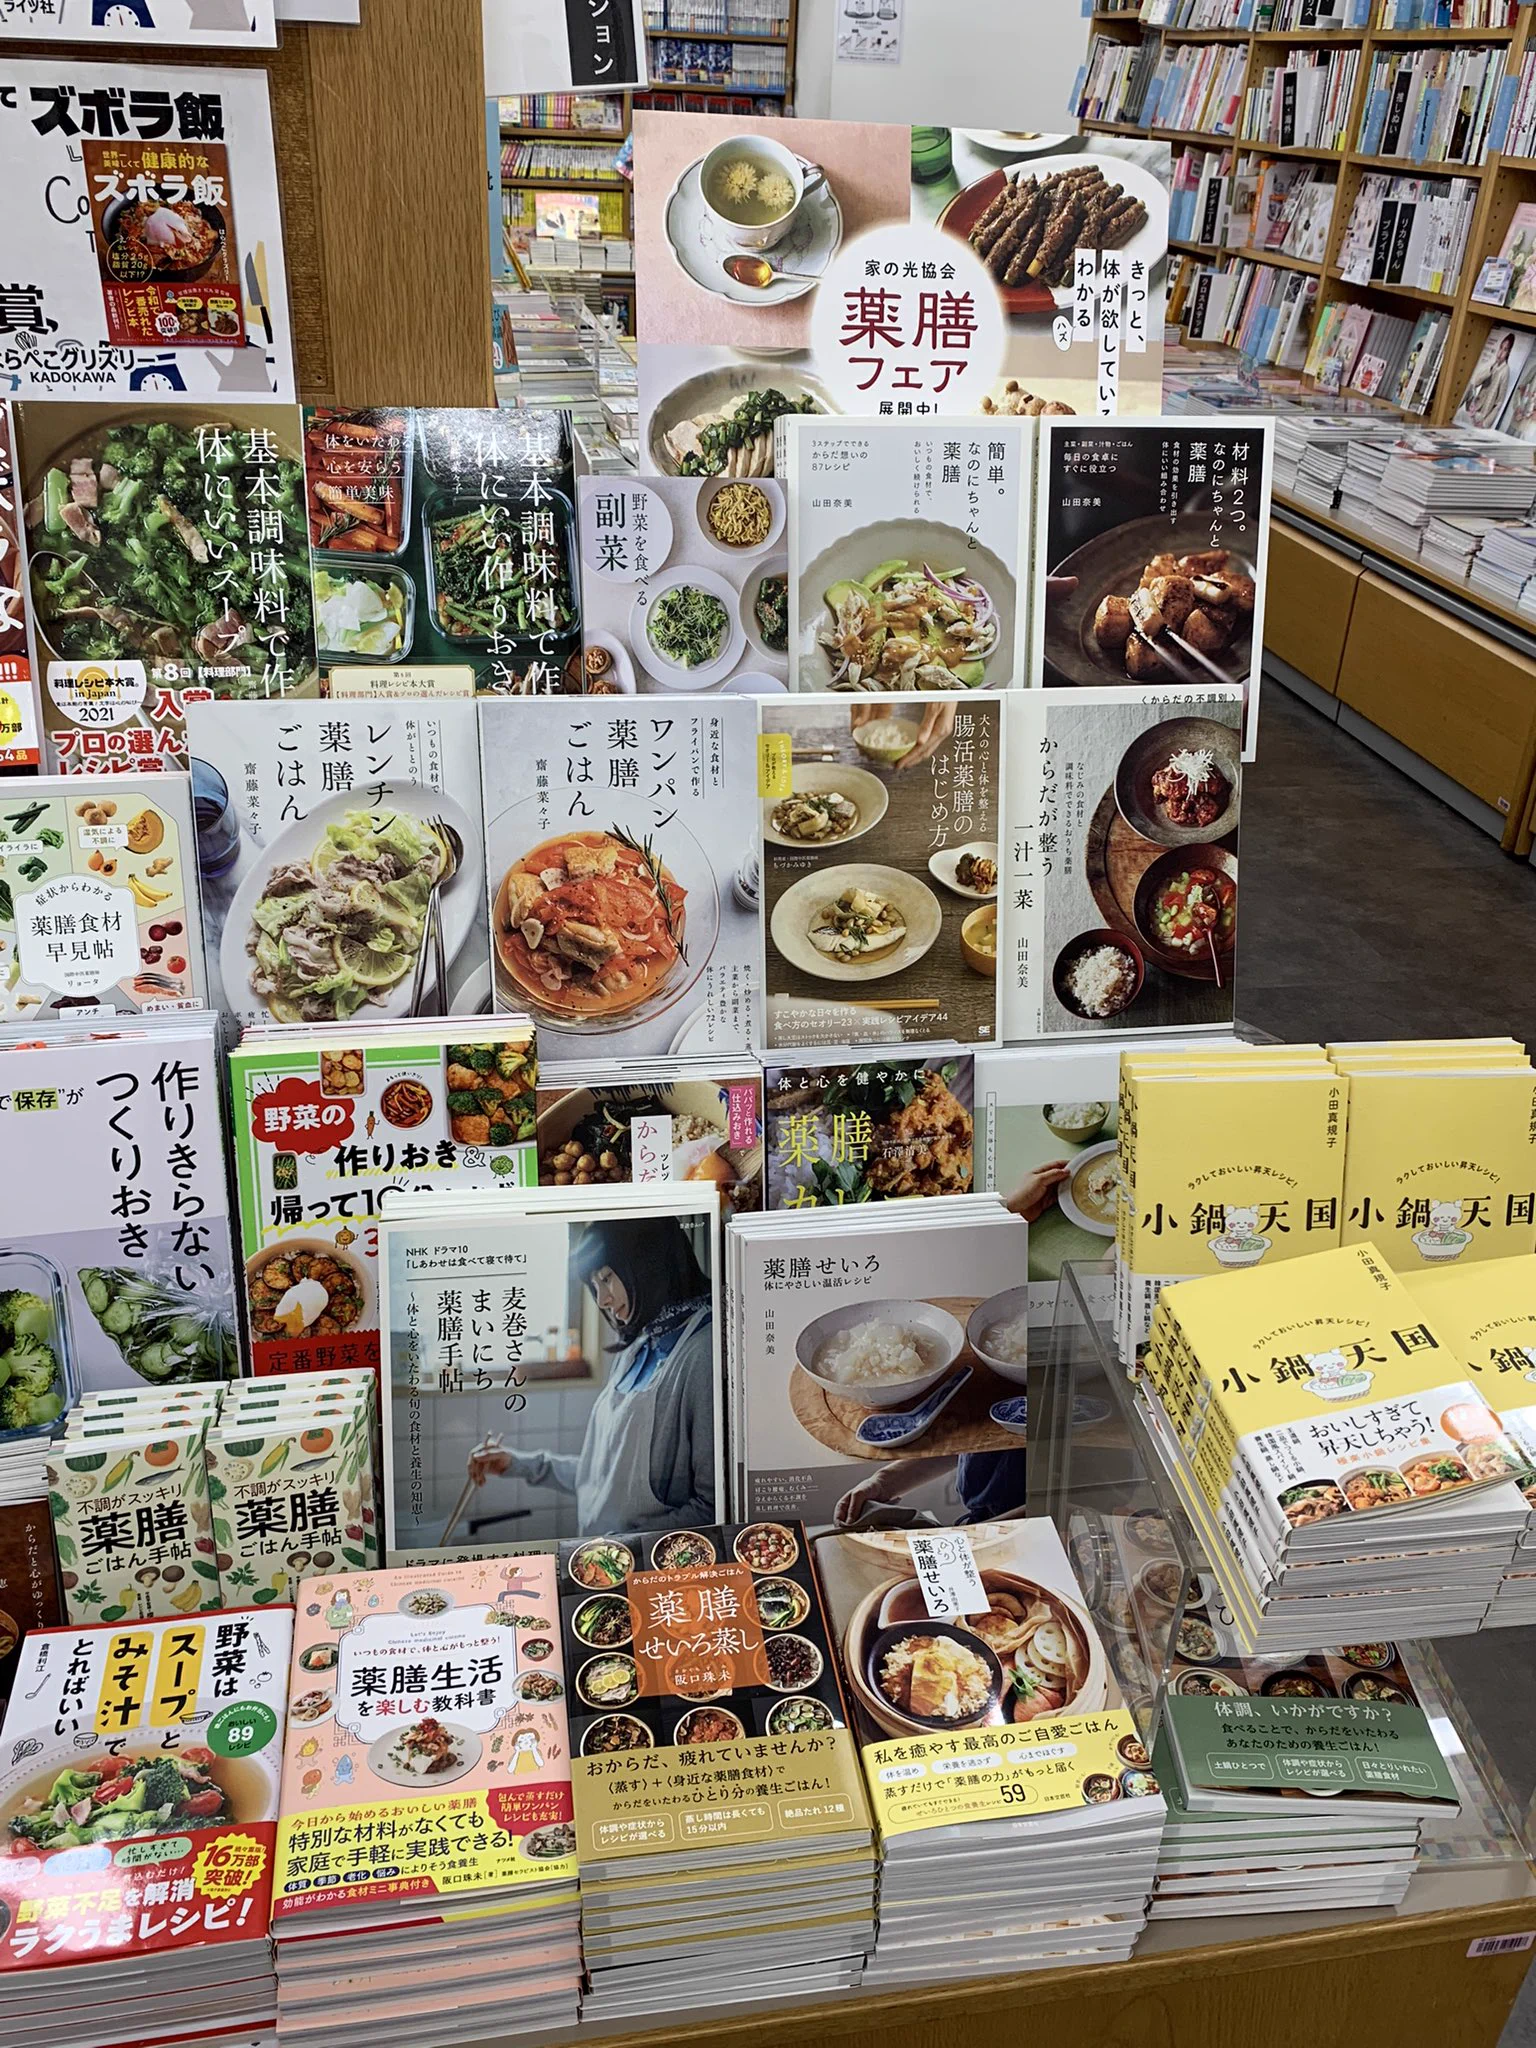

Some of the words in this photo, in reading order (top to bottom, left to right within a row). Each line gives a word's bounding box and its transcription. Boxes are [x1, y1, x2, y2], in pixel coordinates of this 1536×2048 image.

[29, 85, 225, 140] ズボラ飯
[141, 151, 209, 170] 健康的な
[93, 169, 228, 207] ズボラ飯
[1391, 217, 1409, 270] リカちゃん
[865, 260, 956, 280] 家の光協会
[122, 287, 139, 328] レシピ本
[1077, 260, 1095, 327] わかる
[1130, 260, 1146, 343] きっと、
[839, 286, 978, 350] 薬膳
[1056, 321, 1068, 343] ハズ
[30, 372, 116, 383] KADOKAWA
[848, 357, 968, 393] フェア
[811, 439, 870, 448] 3ステップでできる
[812, 450, 869, 460] からだ想いの
[1063, 452, 1119, 462] 毎日の食卓に
[811, 462, 851, 472] 87レシピ
[913, 440, 922, 514] おいしく続けられる
[941, 441, 962, 484] 薬膳
[986, 441, 1007, 496] 簡単。
[1062, 463, 1118, 474] すぐに役立つ
[1159, 441, 1170, 513] 体にいい組み合わせ
[1187, 442, 1208, 484] 薬膳
[328, 484, 395, 501] 簡単美味
[965, 442, 981, 550] なのにちゃんと
[1170, 441, 1181, 525] 食材の効果を引き出す
[1209, 442, 1227, 548] なのにちゃんと
[812, 498, 853, 508] 山田奈美
[1062, 497, 1102, 507] 山田奈美
[195, 428, 249, 656] 体にいいスープ
[595, 492, 629, 572] 副菜
[474, 432, 518, 692] 体にいい作りおき
[632, 492, 650, 607] 野菜を食べる
[151, 663, 191, 681] 第8回
[370, 679, 435, 688] 料理レシピ本大賞
[74, 689, 86, 698] in
[87, 689, 117, 702] Japan
[78, 707, 115, 722] 2021
[319, 722, 356, 792] 薬膳
[405, 720, 418, 787] 体がととのう
[426, 720, 440, 794] いつもの食材で
[607, 719, 641, 789] 薬膳
[690, 718, 701, 798] フライパンで作る
[709, 717, 721, 787] 身近な食材と
[277, 723, 308, 822] ごはん
[366, 723, 398, 835] レンチン
[567, 721, 595, 818] ごはん
[648, 719, 679, 829] ワンパン
[953, 714, 976, 835] 腸活薬膳の
[978, 714, 991, 832] 大人の心と体を整える
[928, 756, 951, 849] はじめ方
[1038, 736, 1059, 878] からだが整う
[1076, 762, 1086, 828] なじみの食材と
[1064, 762, 1074, 876] 調味料でできるおうち薬膳
[1013, 825, 1035, 911] 一汁一菜
[35, 882, 113, 907] 症状からわかる
[30, 911, 122, 937] 薬膳食材
[45, 939, 115, 963] 早見帖
[1017, 937, 1029, 989] 山田奈美
[146, 1002, 200, 1012] めまい・貧血に
[773, 1007, 857, 1018] すこやかな日々を作る
[777, 1069, 927, 1091] 体と心を健やかに
[264, 1105, 346, 1134] 野菜の
[1327, 1087, 1340, 1149] 小田真規子
[778, 1110, 874, 1168] 薬膳
[96, 1071, 152, 1259] つくりおき
[151, 1060, 215, 1292] 作りきらない
[1188, 1165, 1299, 1190] ラクしておいしい昇天レシピ!
[1396, 1160, 1501, 1185] ラクしておいしい昇天レシピ!
[1141, 1199, 1337, 1236] 小鍋天国
[1349, 1192, 1536, 1231] 小鍋天国
[406, 1248, 428, 1257] NHK
[434, 1245, 469, 1255] ドラマ10
[406, 1254, 528, 1270] 「しあわせは食べて寝て待て」
[763, 1254, 881, 1280] 薬膳せいろ
[764, 1275, 872, 1291] 体にやさしい温活レシピ
[1356, 1249, 1391, 1292] 小田真規子
[437, 1290, 464, 1394] 薬膳手帖
[471, 1289, 495, 1391] まいにち
[765, 1308, 775, 1356] 山田奈美
[1253, 1317, 1371, 1350] ラクしておいしい昇天レシピ!
[268, 1342, 379, 1373] 定番野菜を
[501, 1286, 528, 1414] 麦巻さんの
[1221, 1323, 1440, 1394] 小鍋天国
[1309, 1400, 1423, 1439] おいしすぎて
[1319, 1417, 1433, 1458] 昇天しちゃう!
[77, 1484, 182, 1513] 不調がスッキリ
[234, 1471, 336, 1499] 不調がスッキリ
[78, 1500, 189, 1557] 薬膳
[234, 1488, 340, 1541] 薬膳
[85, 1541, 192, 1575] ごはん手帖
[239, 1528, 343, 1558] ごはん手帖
[632, 1567, 744, 1586] からだのトラブル解決ごはん
[913, 1539, 950, 1615] 薬膳せいろ
[953, 1535, 978, 1588] 心と体が整う
[647, 1583, 742, 1630] 薬膳
[213, 1621, 250, 1698] 野菜は
[353, 1636, 501, 1657] いつもの食材で、体と心がもっと整う!
[639, 1628, 760, 1661] せいろ蒸し
[55, 1638, 94, 1737] とればいい
[350, 1655, 504, 1697] 薬膳生活
[674, 1671, 732, 1688] 阪口珠未
[101, 1637, 149, 1757] みそ汁で
[357, 1688, 497, 1717] を楽しむ教科書
[1213, 1701, 1394, 1722] 体調、いかがですか?
[226, 1727, 255, 1743] 89
[228, 1741, 252, 1752] レシピ
[873, 1718, 1119, 1767] 私を癒やす最高のご自愛ごはん
[1221, 1722, 1400, 1740] 食べることで、からだをいたわる
[1226, 1737, 1381, 1754] あなたのための養生ごはん!
[586, 1735, 838, 1778] おからだ、疲れていませんか?
[942, 1756, 993, 1771] 栄養を逃さず
[1018, 1746, 1066, 1761] 心までほぐす
[1214, 1760, 1266, 1772] 土鍋ひとつで
[1282, 1758, 1344, 1769] 体調や症状から
[1362, 1761, 1428, 1775] 日々とりいれたい
[883, 1760, 1077, 1800] 蒸すだけで「薬膳の力」がもっと届く
[885, 1766, 920, 1779] 体を温め
[1285, 1767, 1347, 1779] レシピが選べる
[1365, 1771, 1401, 1781] 薬膳食材
[498, 1791, 565, 1803] 包んで蒸すだけ
[500, 1801, 560, 1813] 簡単ワンパン
[612, 1777, 833, 1811] からだをいたわるひとり分の養生ごはん!
[1001, 1783, 1027, 1805] 59
[291, 1797, 478, 1831] 今日から始めるおいしい薬膳
[599, 1818, 666, 1835] 体調や症状から
[685, 1807, 766, 1824] 蒸し時間は長くても
[686, 1822, 727, 1834] 15分以内
[127, 1841, 179, 1856] 忙しすぎて
[288, 1812, 485, 1853] 特別な材料がなくても
[600, 1829, 667, 1845] レシピが選べる
[286, 1829, 514, 1877] 家庭で手軽に実践できる!
[400, 1857, 479, 1875] によりそう食養生
[202, 1867, 251, 1888] 突破!
[288, 1879, 309, 1893] 体質
[316, 1874, 338, 1888] 季節
[345, 1870, 368, 1883] 老化
[374, 1865, 397, 1878] 悩み
[15, 1877, 195, 1925] 野菜不足を解消
[282, 1878, 431, 1911] 効能がわかる食材ミニ事典付き
[9, 1898, 255, 1960] ラクうまレシピ!
